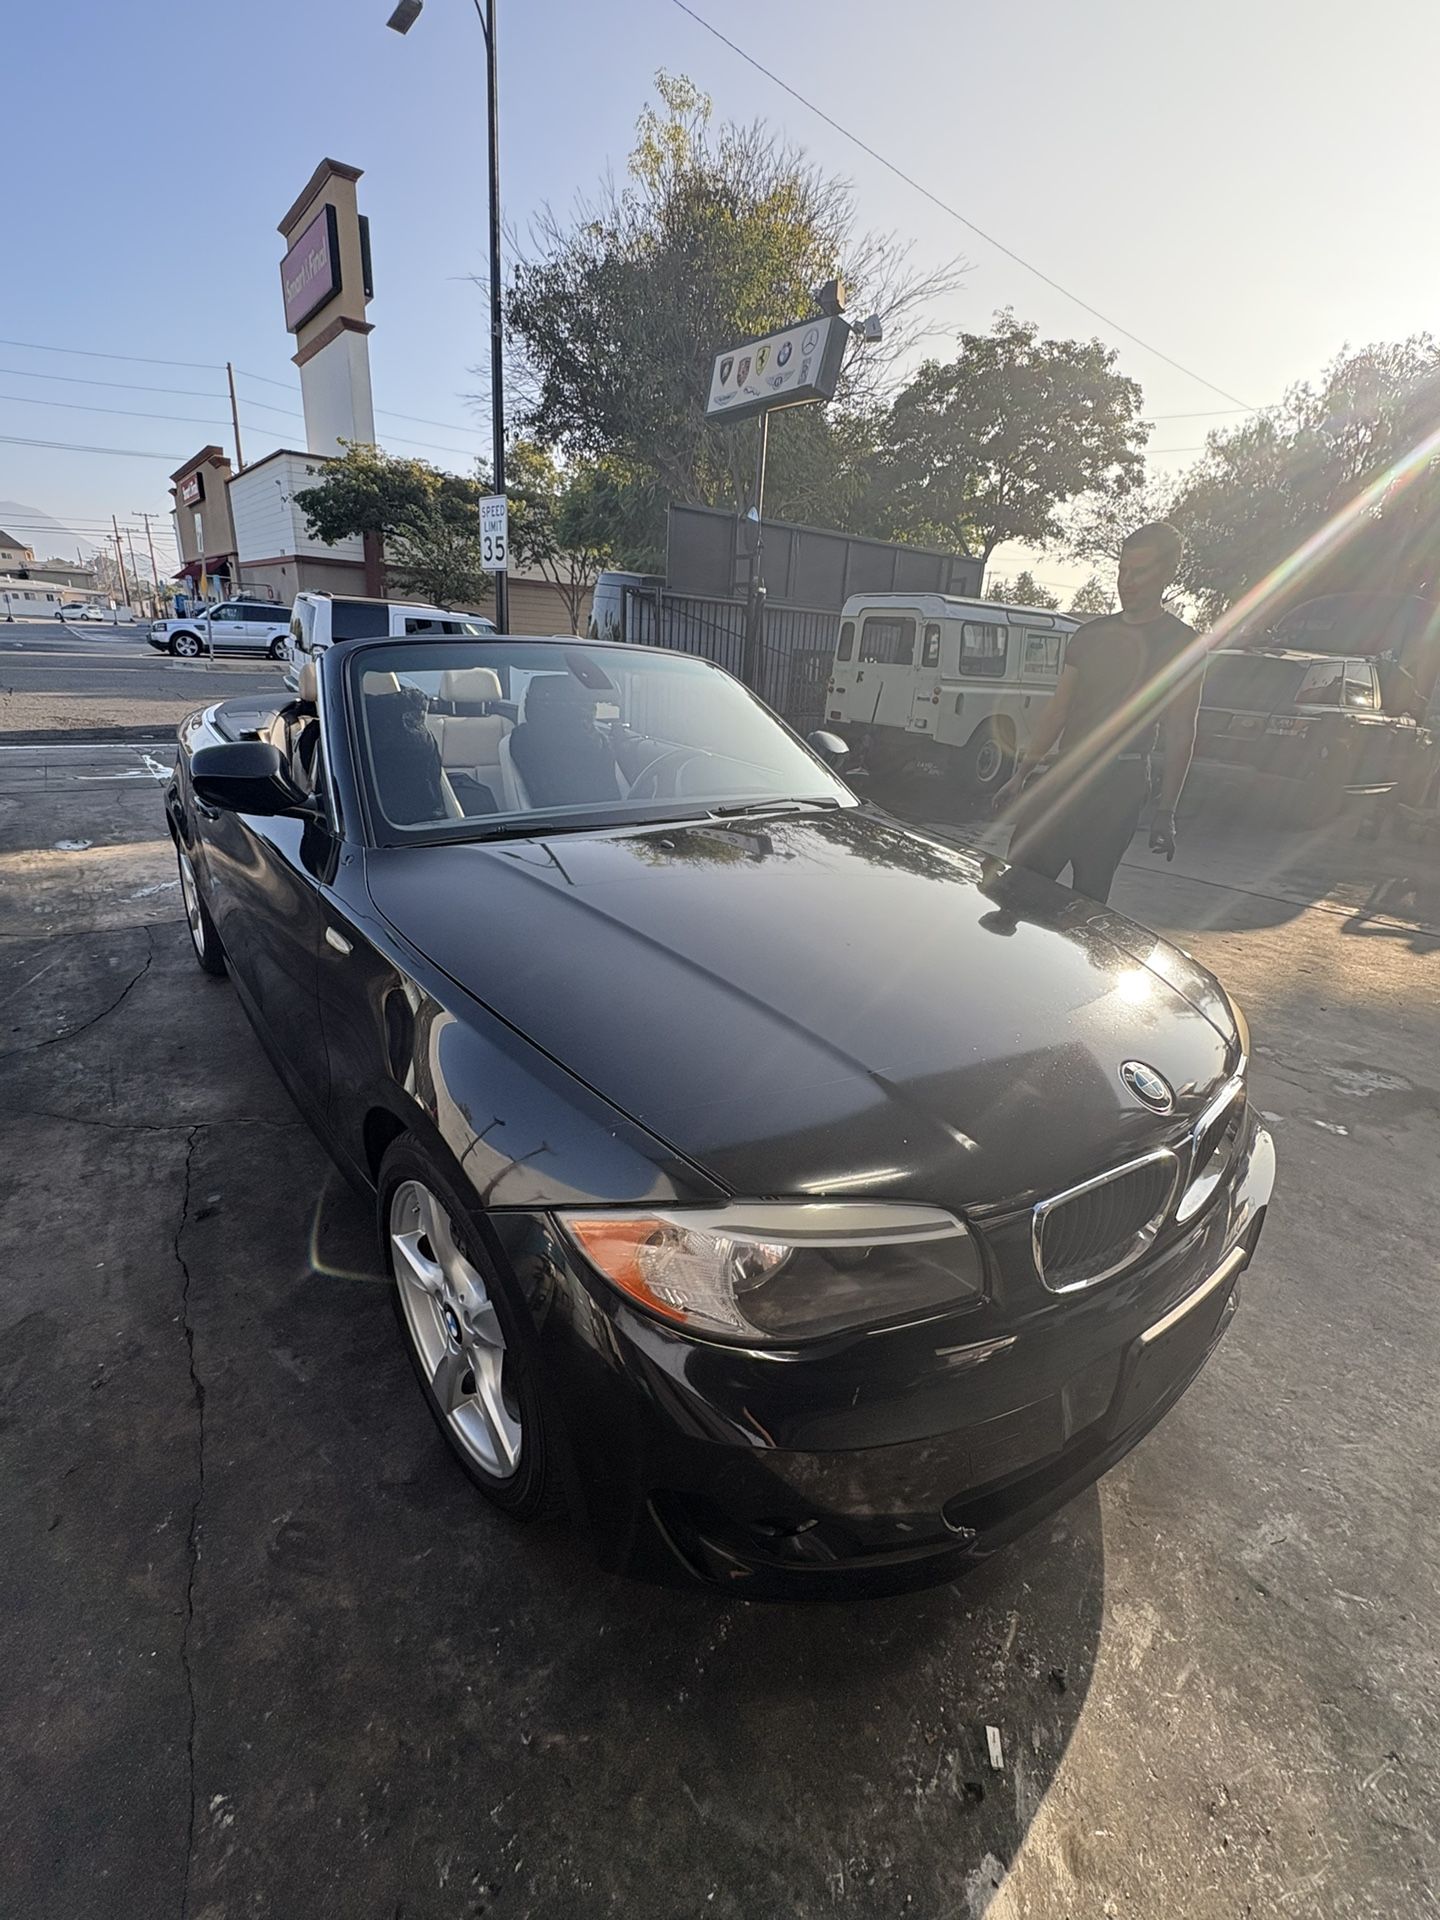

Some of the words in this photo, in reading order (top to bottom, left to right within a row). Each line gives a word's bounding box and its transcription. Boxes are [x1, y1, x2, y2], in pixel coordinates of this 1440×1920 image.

[481, 504, 505, 518] SPEED
[484, 520, 503, 533] LIMIT
[483, 535, 505, 562] 35
